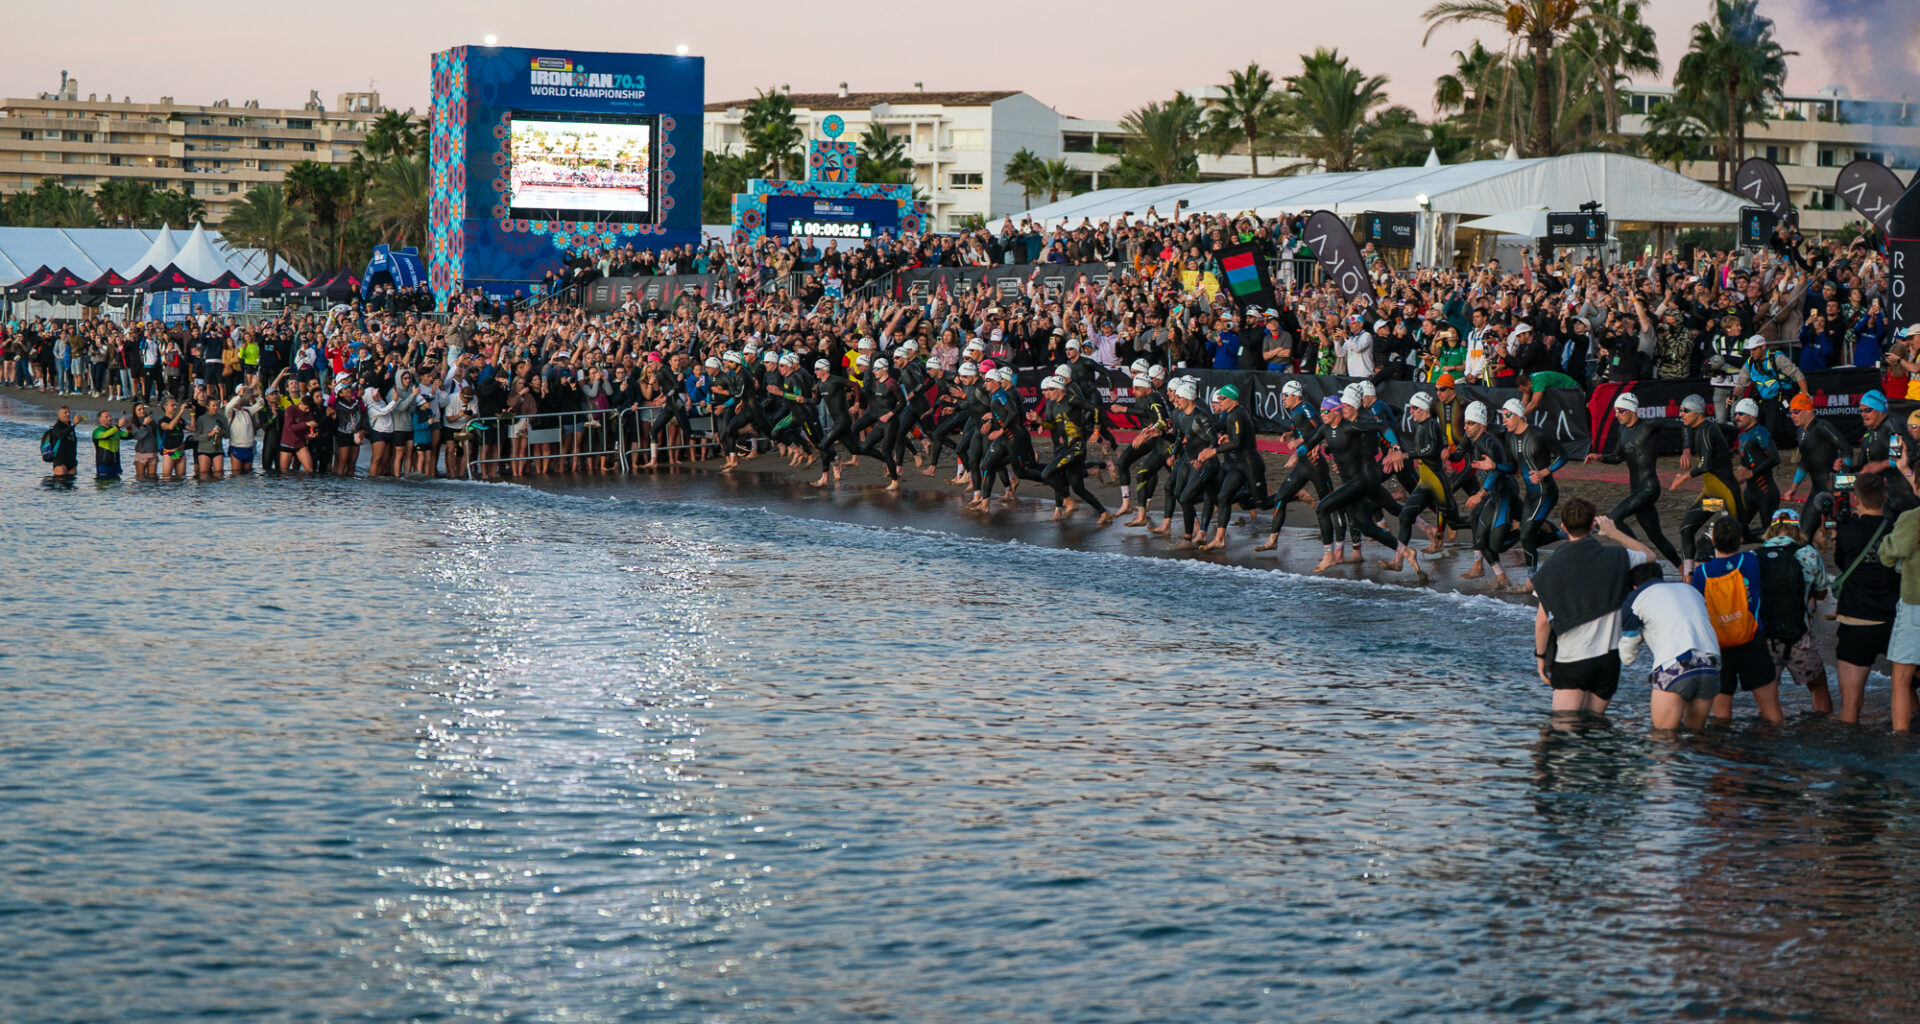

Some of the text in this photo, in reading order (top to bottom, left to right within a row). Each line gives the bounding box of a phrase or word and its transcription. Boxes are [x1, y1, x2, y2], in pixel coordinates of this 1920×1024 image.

[614, 74, 646, 89] 70.3
[531, 86, 645, 99] WORLD CHAMPIONSHIP
[804, 223, 860, 237] 00:00:02
